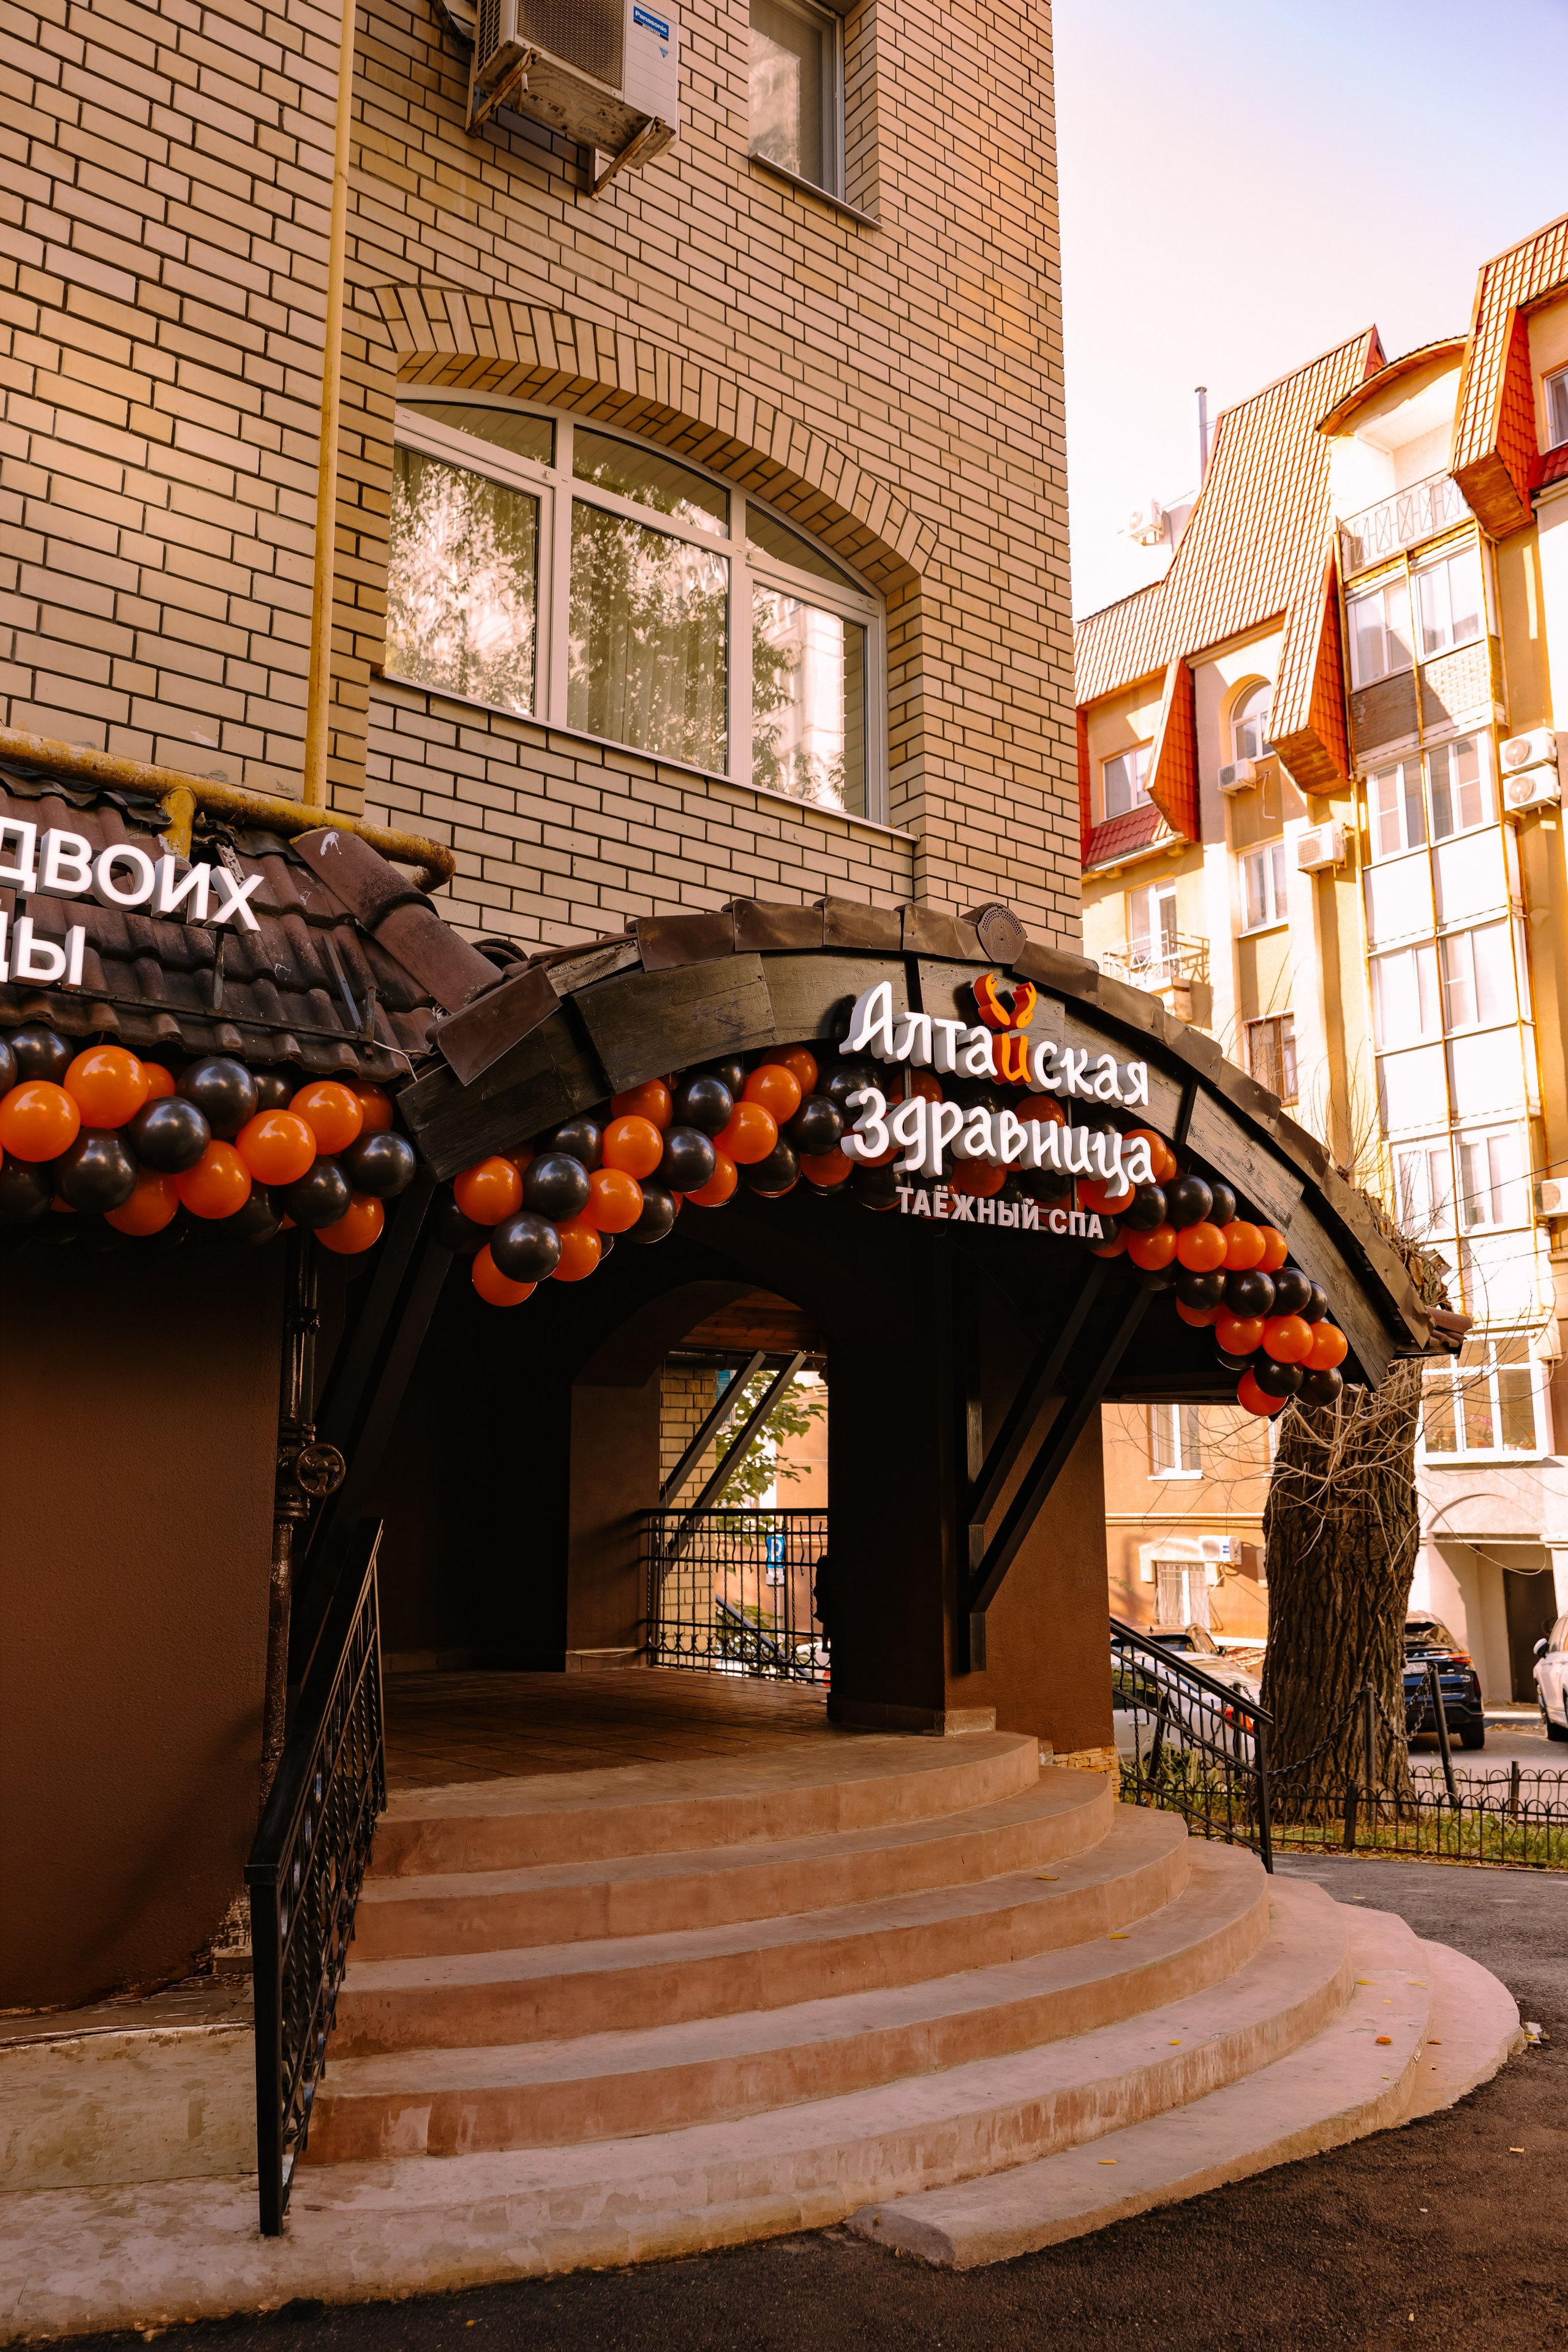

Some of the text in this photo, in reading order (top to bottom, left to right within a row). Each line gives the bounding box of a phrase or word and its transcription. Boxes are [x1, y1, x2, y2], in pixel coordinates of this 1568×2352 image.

[635, 10, 668, 33] Panasonic
[642, 23, 661, 37] INVERTER
[0, 816, 265, 935] ДВОИХ
[839, 972, 1149, 1107] Алтайская
[842, 1087, 1156, 1197] Здравница
[895, 1185, 1104, 1239] ТАЁЖНЫЙ СПА
[771, 1538, 783, 1563] P
